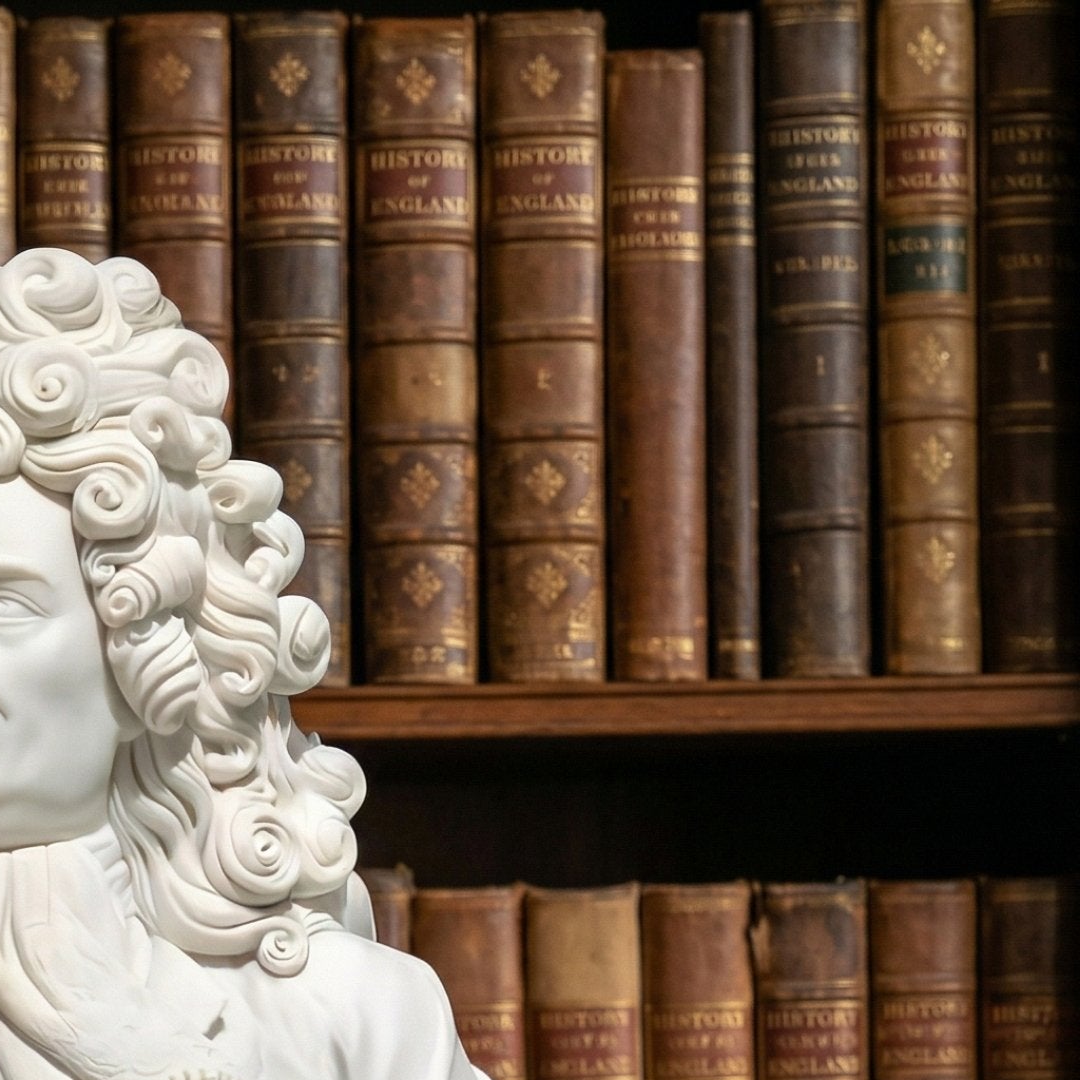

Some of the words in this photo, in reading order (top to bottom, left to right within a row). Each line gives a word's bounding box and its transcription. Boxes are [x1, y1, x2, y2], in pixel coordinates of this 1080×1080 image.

[370, 149, 466, 172] HISTORY
[495, 146, 594, 168] HISTORY
[370, 196, 469, 216] ENGLAND
